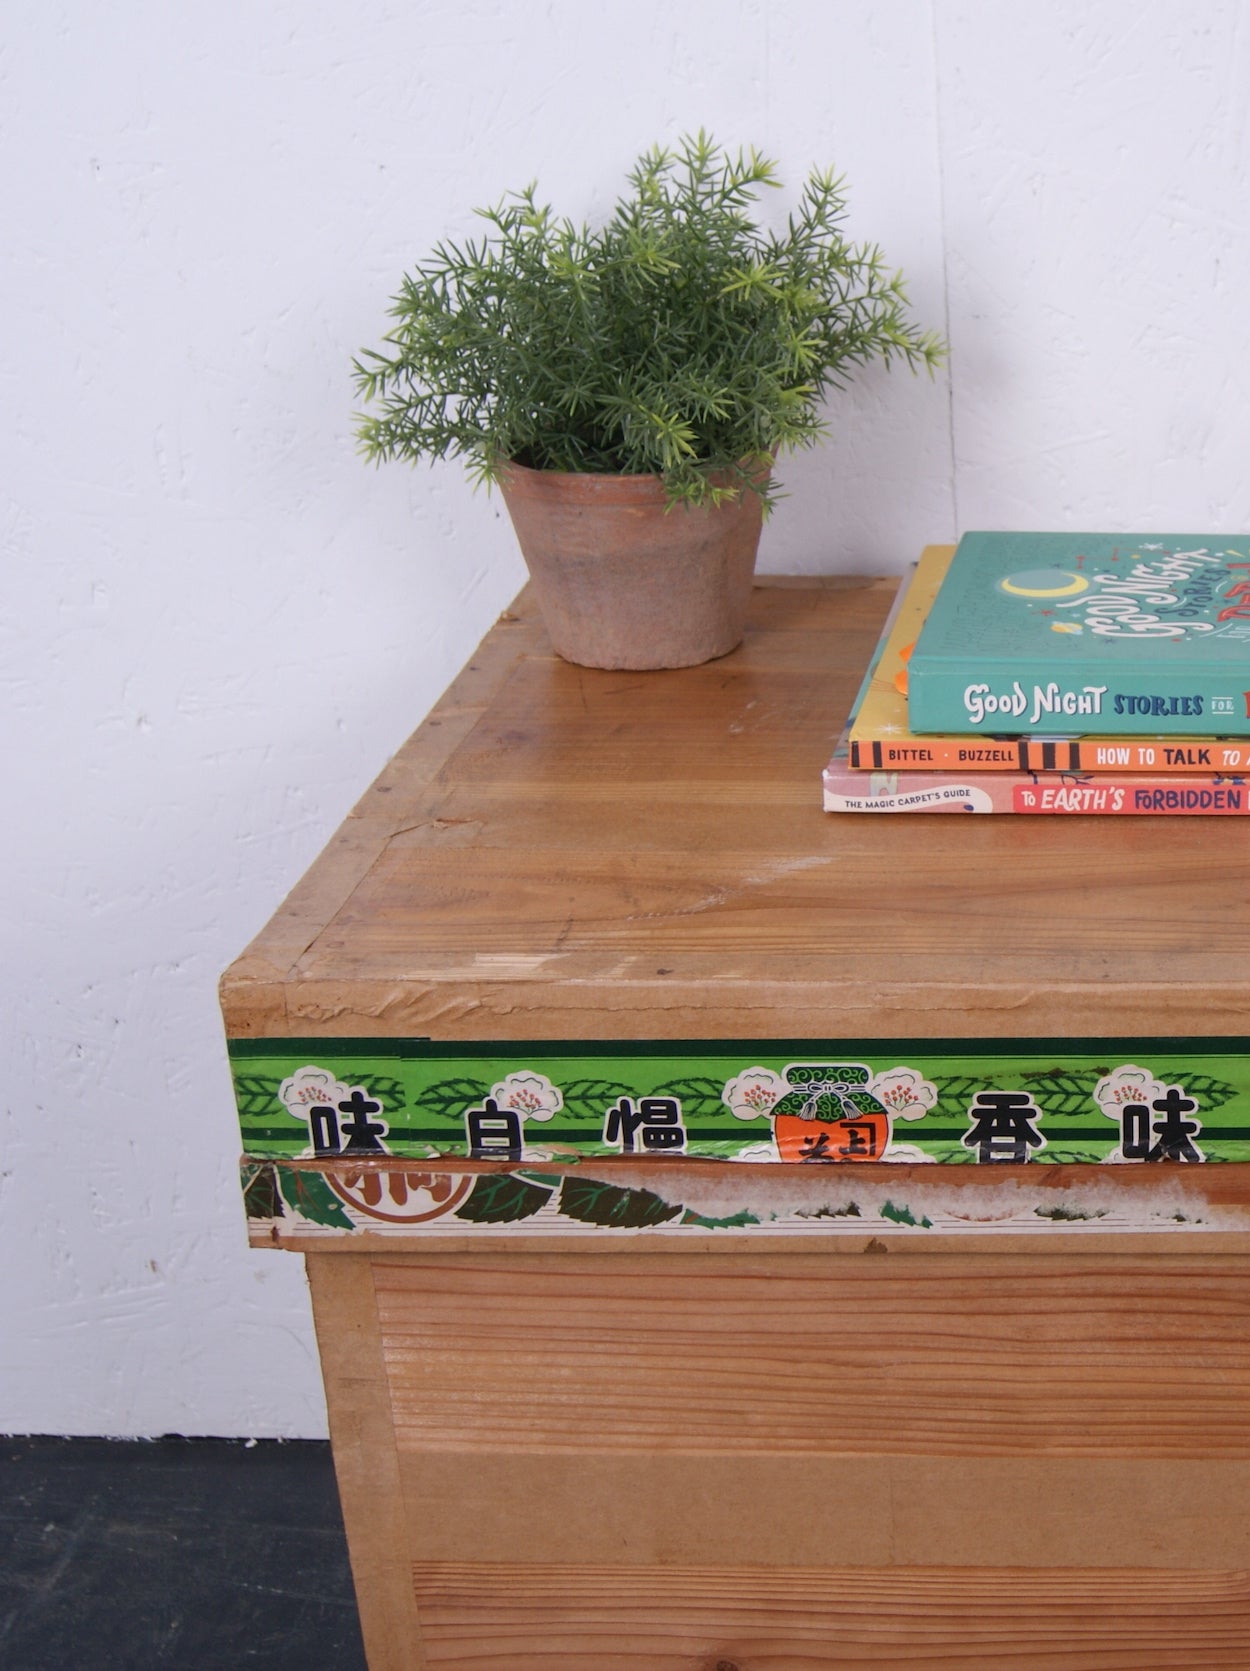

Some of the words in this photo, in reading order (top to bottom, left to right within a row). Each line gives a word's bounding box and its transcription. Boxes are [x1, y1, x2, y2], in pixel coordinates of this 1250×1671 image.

[1093, 549, 1221, 604] NIGHT
[1155, 568, 1231, 616] STORIES
[1113, 694, 1204, 716] STORIES
[1211, 701, 1234, 711] FOR
[888, 749, 934, 761] BITTEL
[958, 750, 1014, 762] BUZZELL
[1097, 748, 1130, 765] HOW
[1138, 748, 1156, 765] TO
[1163, 748, 1211, 765] TALK
[1222, 750, 1241, 766] TO
[845, 800, 863, 809] THE
[865, 799, 895, 809] MAGIC
[897, 792, 942, 807] CARPET'S
[943, 789, 971, 798] GUIDE
[1040, 786, 1125, 812] EARTH'S
